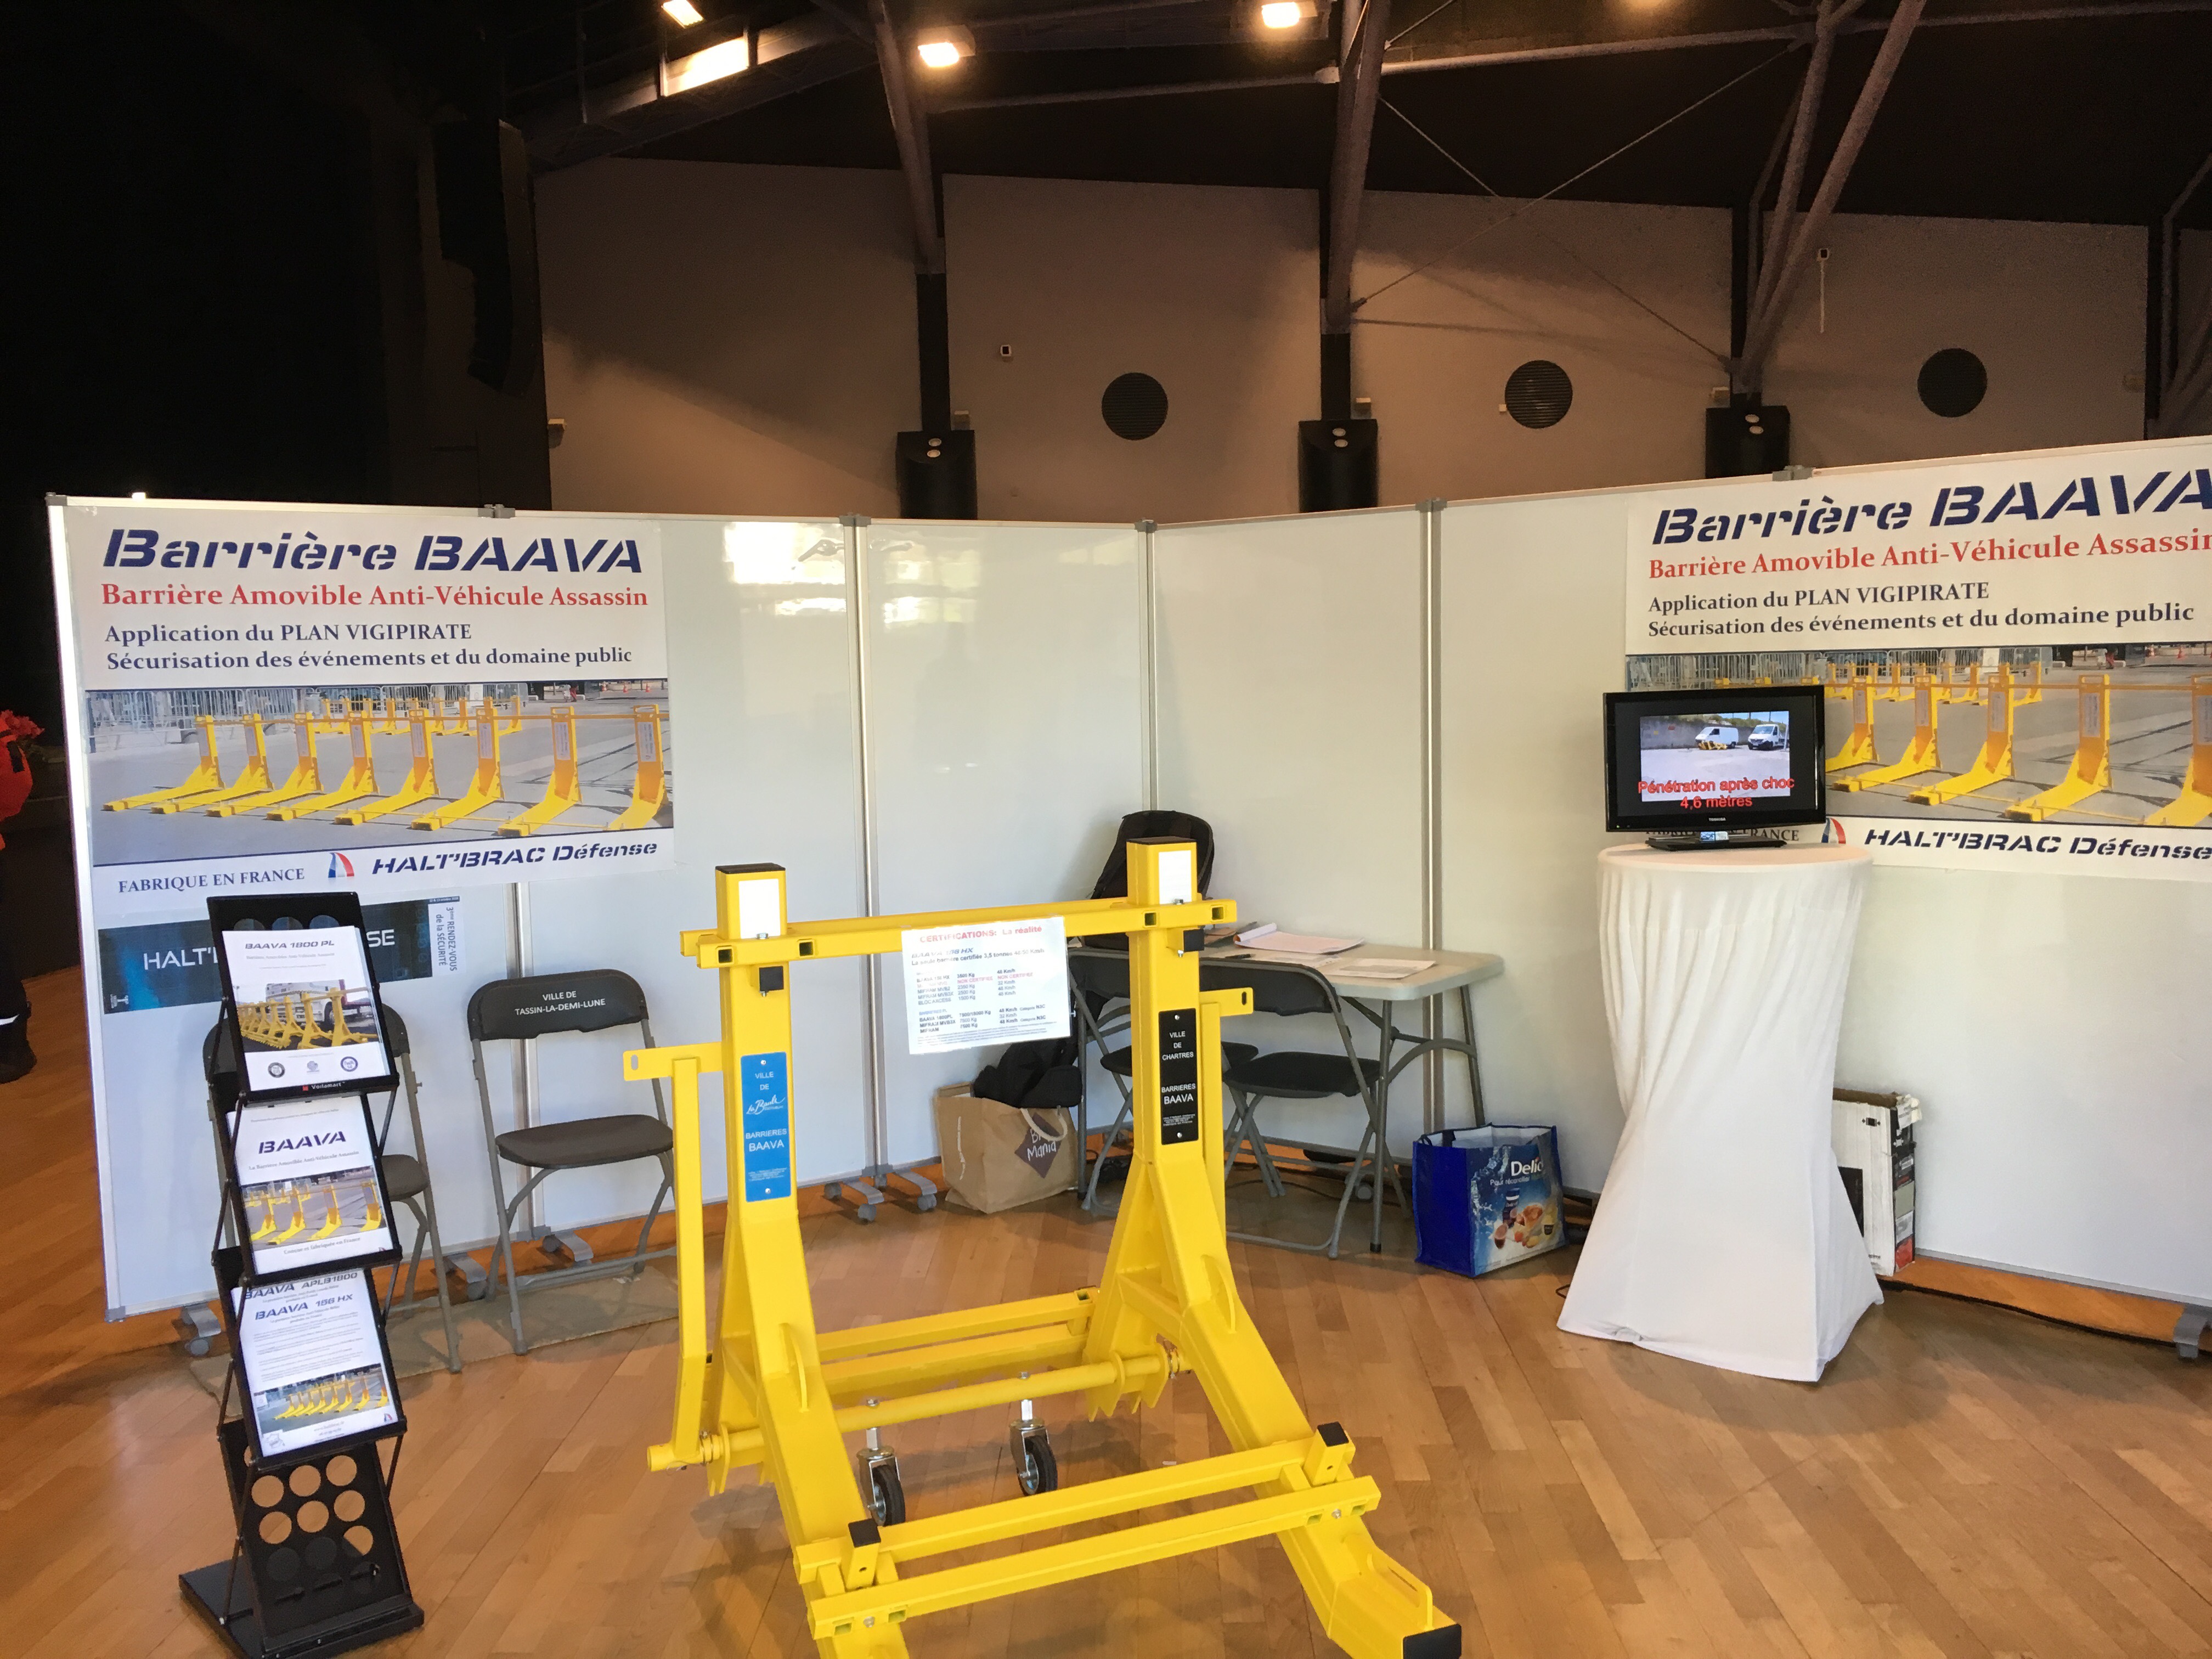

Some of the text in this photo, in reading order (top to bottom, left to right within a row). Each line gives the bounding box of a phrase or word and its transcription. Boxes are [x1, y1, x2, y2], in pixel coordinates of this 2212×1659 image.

[1652, 469, 2212, 545] Barrière BAAVA
[103, 529, 642, 573] Barrière BAAVA
[1649, 556, 1746, 579] Barrière
[1752, 546, 1876, 573] Amovible
[1881, 534, 2080, 567] Anti-Véhicule
[101, 583, 648, 606] Barrière Amovible Anti-Véhicule Assassin
[1648, 582, 1990, 616] Application du PLAN VIGIPIRATE
[1649, 602, 2194, 637] Sécurisation des événements et du domaine public
[105, 623, 472, 646] Application du PLAN VIGIPIRATE
[107, 647, 632, 670] Sécurisation des événements et du domaine public
[1638, 776, 1795, 794] Pénétration après choc
[1680, 795, 1753, 810] 4,6 mètres
[1864, 829, 2212, 860] HALT'BRAC Défense
[373, 841, 658, 875] HALT'BRAC Défense
[118, 868, 305, 894] FABRIQUE EN FRANCE
[1014, 926, 1042, 934] réalité
[290, 940, 319, 949] 1800
[437, 933, 449, 967] SÉCURITÉ
[447, 921, 458, 972] RENDEZ-VOUS
[960, 953, 983, 961] certifiée
[542, 990, 577, 1001] VILLE DE
[514, 998, 606, 1016] TASSIN-LA-DEMI-LUNE
[1169, 1030, 1186, 1039] VILLE
[1162, 1052, 1194, 1061] CHARTRES
[1161, 1083, 1196, 1093] BARRIERES
[1164, 1093, 1194, 1105] BAAVA
[258, 1131, 346, 1154] BAAVA
[746, 1128, 787, 1139] BARRIERES
[749, 1140, 785, 1152] BAAVA
[1027, 1141, 1057, 1161] Mania
[245, 1283, 295, 1300] BAAVA
[255, 1302, 309, 1321] BAAVA
[337, 1293, 354, 1302] HX
